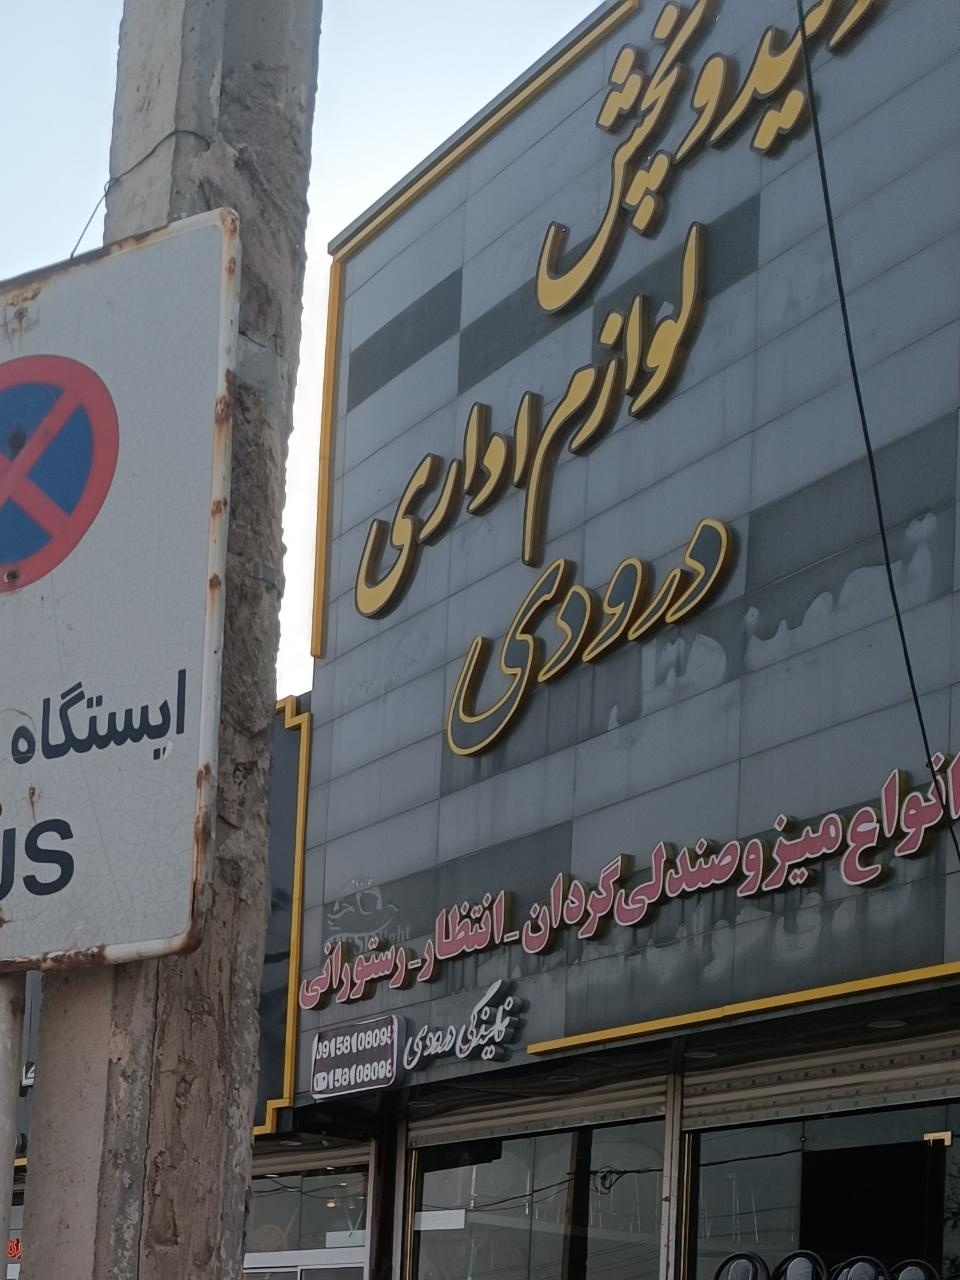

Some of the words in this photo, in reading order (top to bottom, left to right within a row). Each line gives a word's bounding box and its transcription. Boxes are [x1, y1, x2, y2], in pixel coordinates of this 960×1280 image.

[521, 221, 709, 567] لوازم
[354, 391, 541, 619] اداری
[447, 517, 734, 757] درودی
[11, 668, 188, 765] ایستگاه
[761, 812, 843, 892] میز
[841, 750, 960, 885] انواع
[521, 852, 624, 955] گردان
[614, 840, 744, 927] صندلی
[736, 838, 764, 897] و
[298, 935, 408, 1010] رستورانی
[417, 888, 505, 982] انتظار
